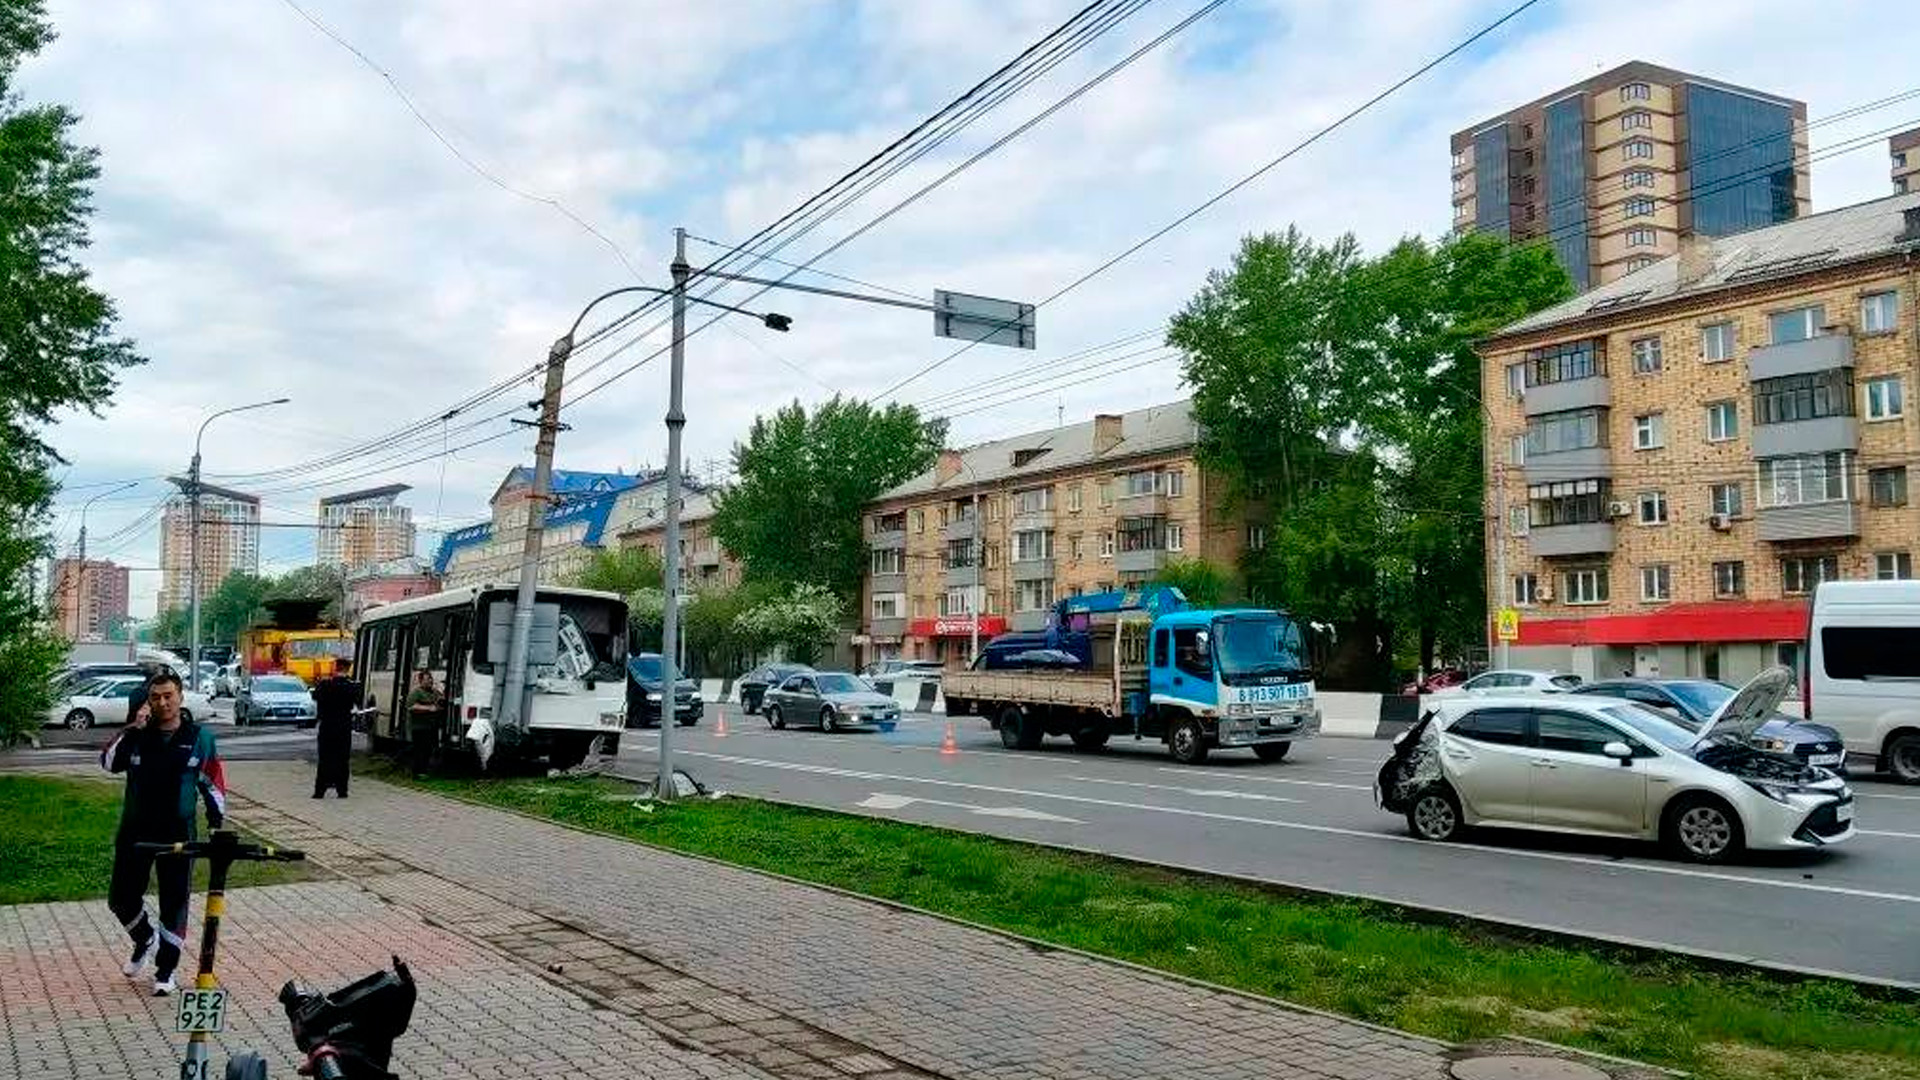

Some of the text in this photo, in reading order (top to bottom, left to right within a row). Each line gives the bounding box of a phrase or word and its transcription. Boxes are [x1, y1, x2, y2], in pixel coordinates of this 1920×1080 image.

[1239, 690, 1246, 702] 8
[1249, 688, 1267, 701] 913
[1268, 687, 1285, 700] 507
[183, 992, 223, 1010] PE2
[181, 1011, 219, 1029] 921
